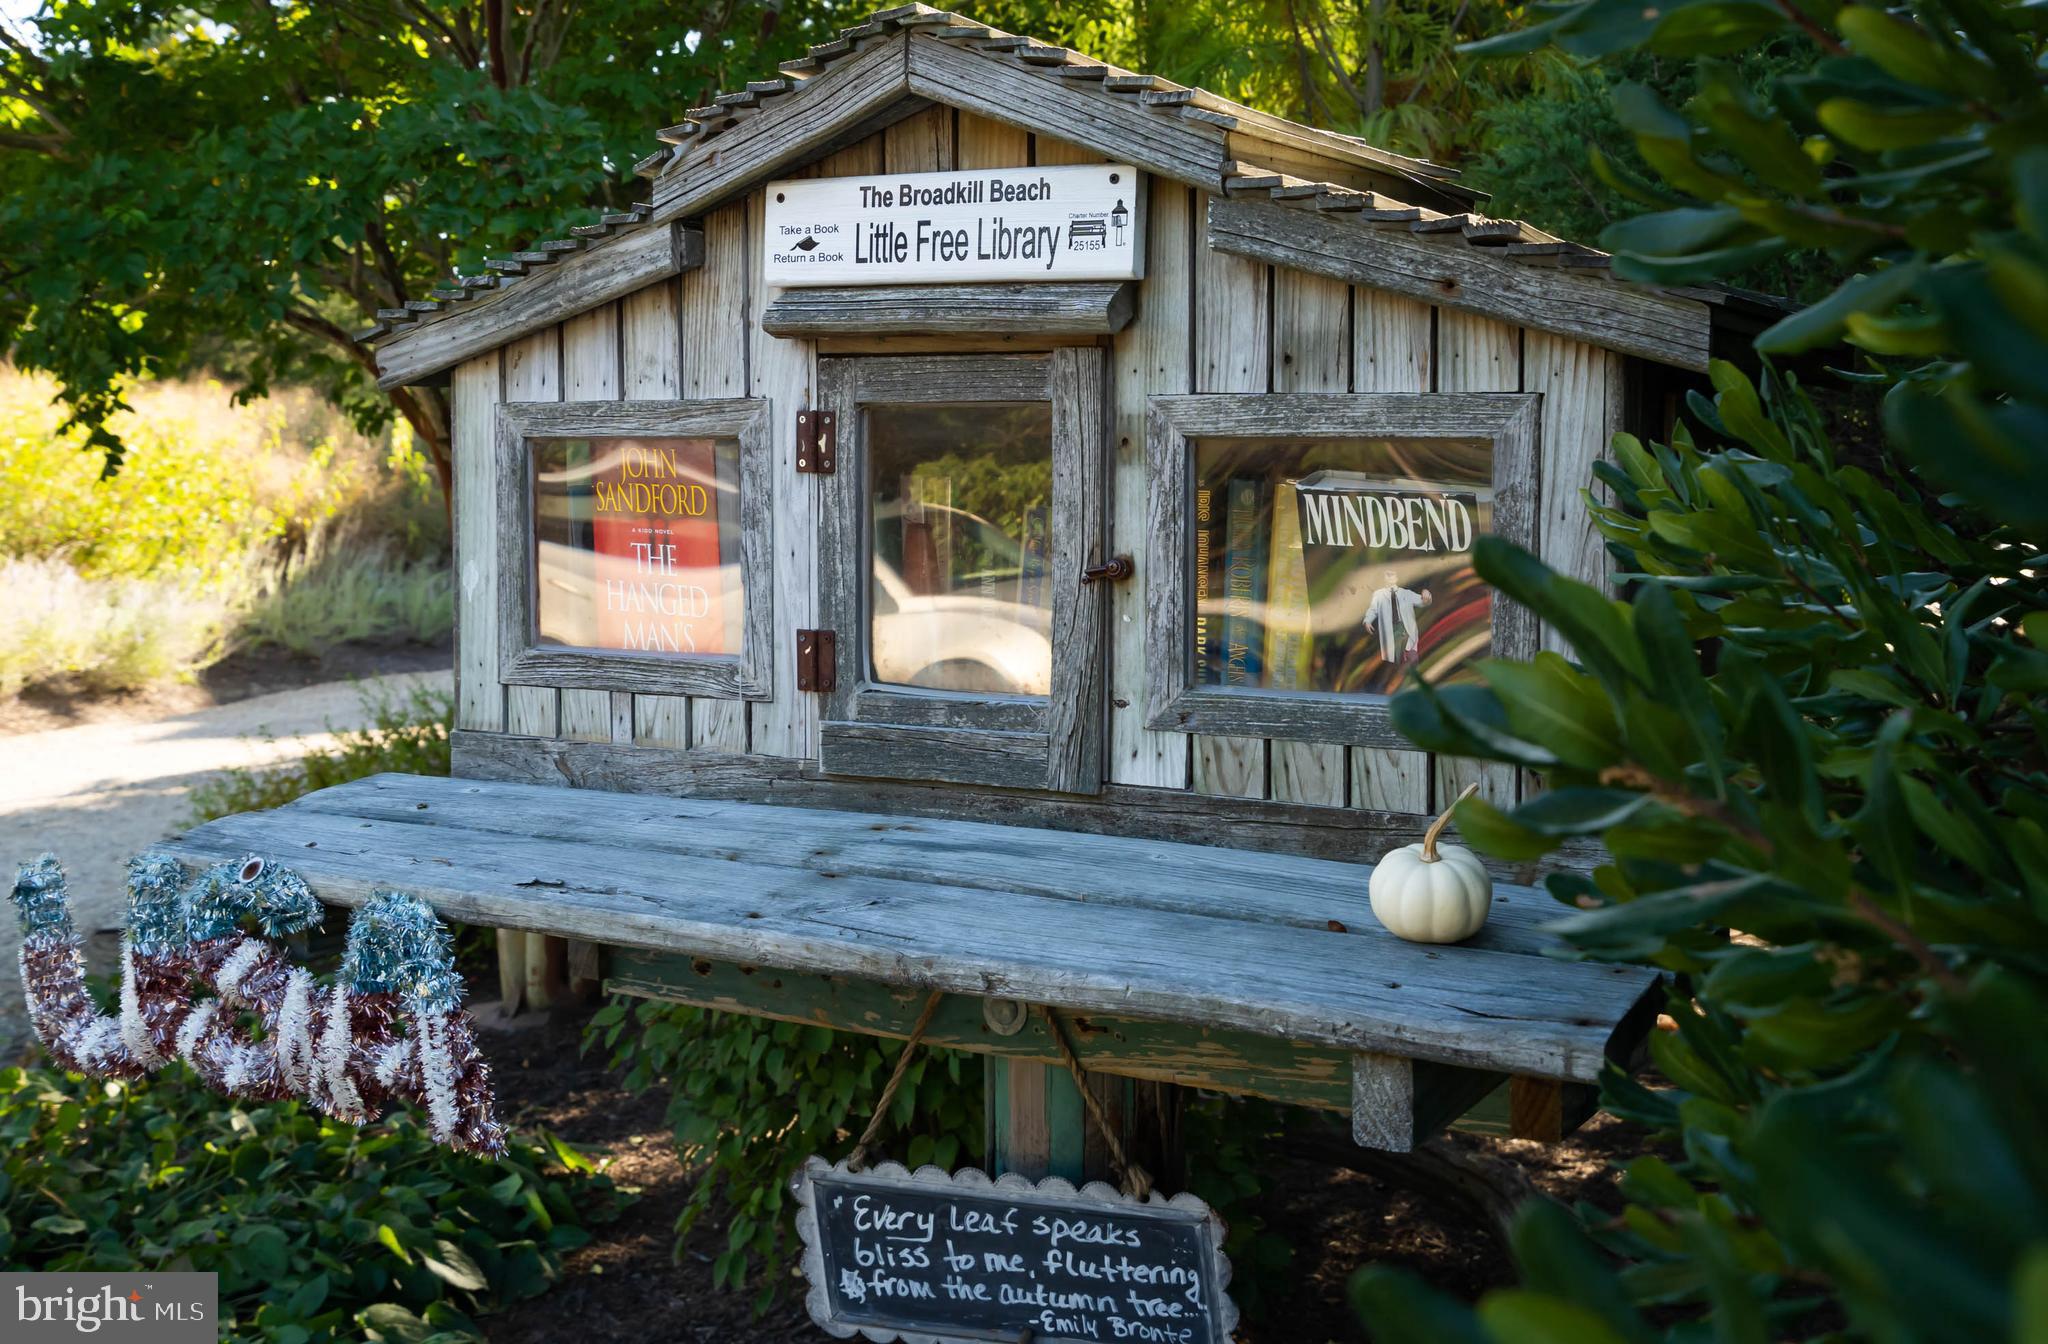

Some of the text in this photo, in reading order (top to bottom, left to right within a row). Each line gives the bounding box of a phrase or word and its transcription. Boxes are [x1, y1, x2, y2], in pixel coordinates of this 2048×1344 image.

[859, 177, 1051, 208] The Broadkill Beach
[779, 224, 839, 235] Take a Book
[855, 217, 1061, 270] Little Free Library
[1073, 240, 1101, 251] 25155
[773, 252, 844, 263] Return a Book
[620, 447, 678, 485] JOHN
[595, 481, 708, 517] SANDFORD
[1303, 493, 1472, 552] MINDBEND
[630, 542, 678, 577] THE
[606, 579, 709, 618] HANGED
[622, 619, 696, 653] MAN'S
[1032, 1216, 1141, 1247] speaks
[854, 1237, 930, 1267] bliss
[943, 1239, 976, 1273] to
[1042, 1249, 1200, 1308] fluttering
[866, 1268, 937, 1299] from
[941, 1275, 992, 1301] the
[999, 1284, 1118, 1314] autumn
[1107, 1316, 1192, 1344] Bronte
